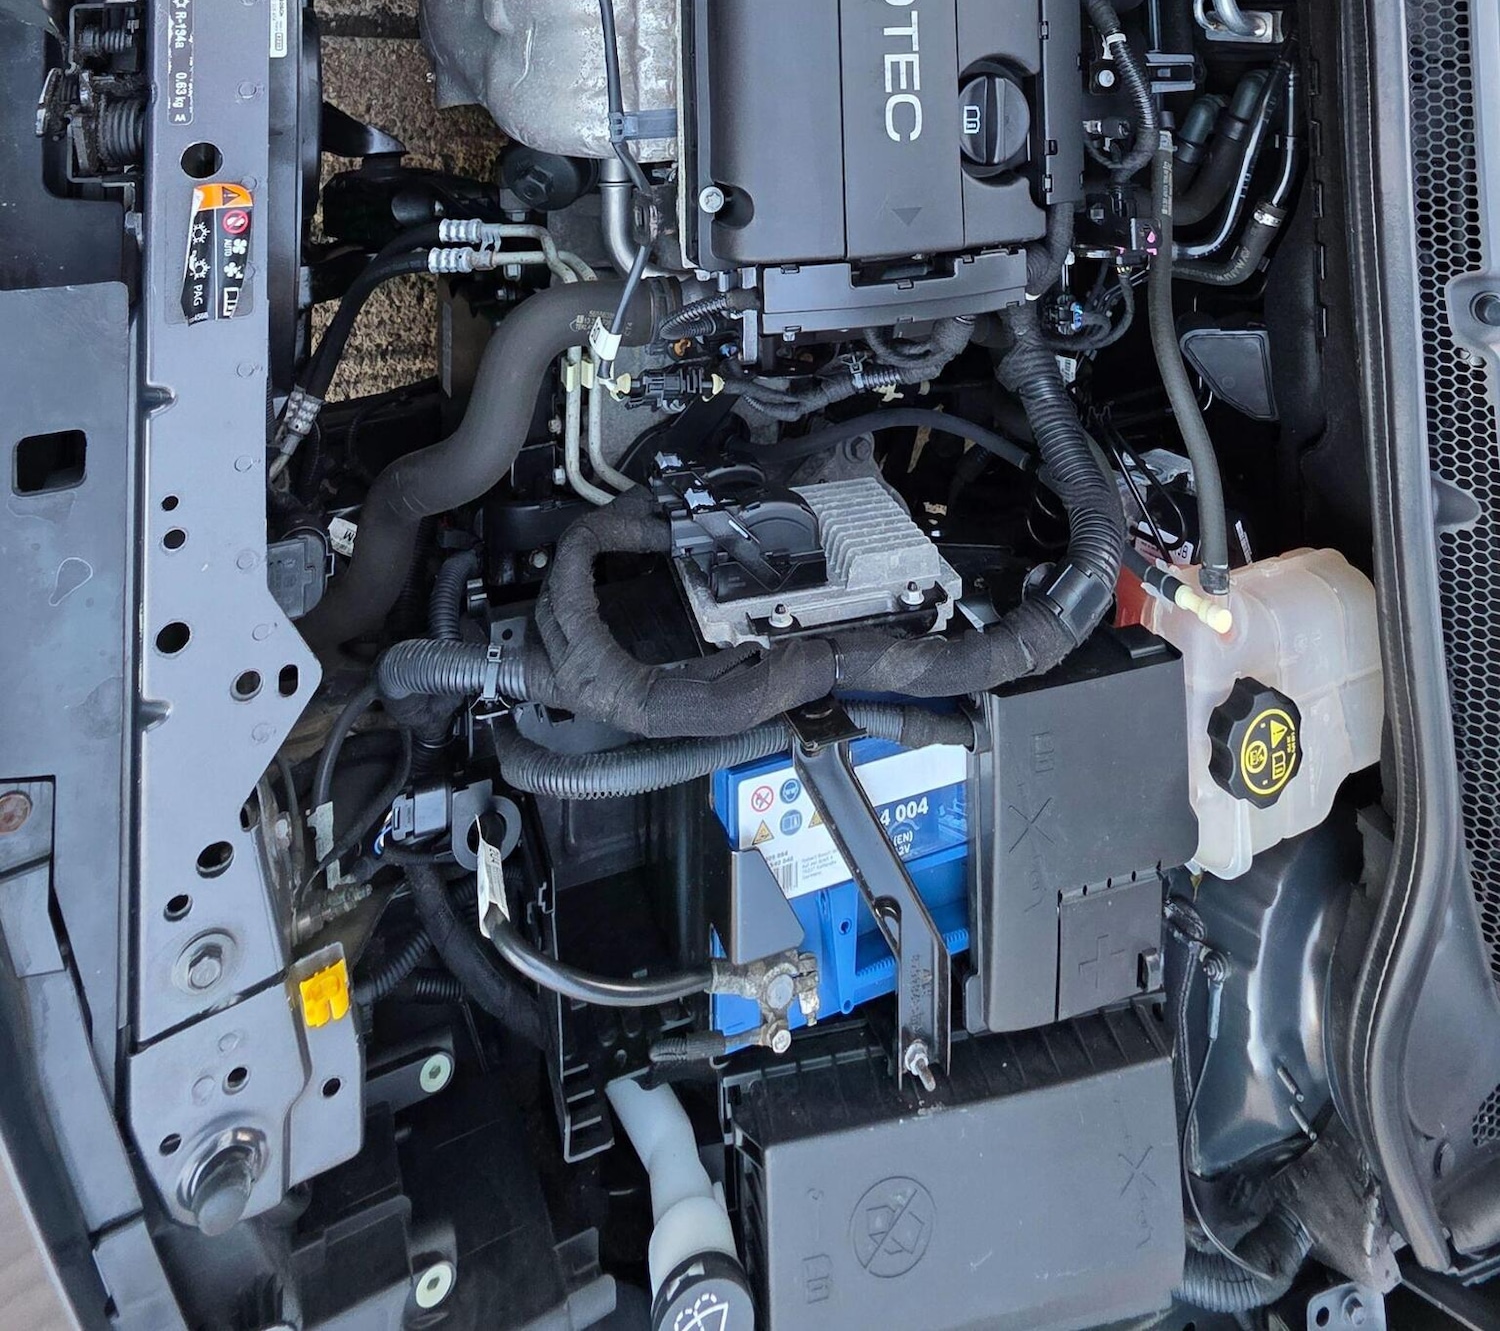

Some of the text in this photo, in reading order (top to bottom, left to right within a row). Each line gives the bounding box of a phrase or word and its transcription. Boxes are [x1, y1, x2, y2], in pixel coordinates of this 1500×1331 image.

[174, 11, 187, 49] R-134a
[175, 72, 187, 95] 0.63
[224, 238, 233, 256] AUTO
[193, 284, 203, 307] PAG
[880, 796, 929, 826] 4 004
[893, 830, 913, 847] (EN)
